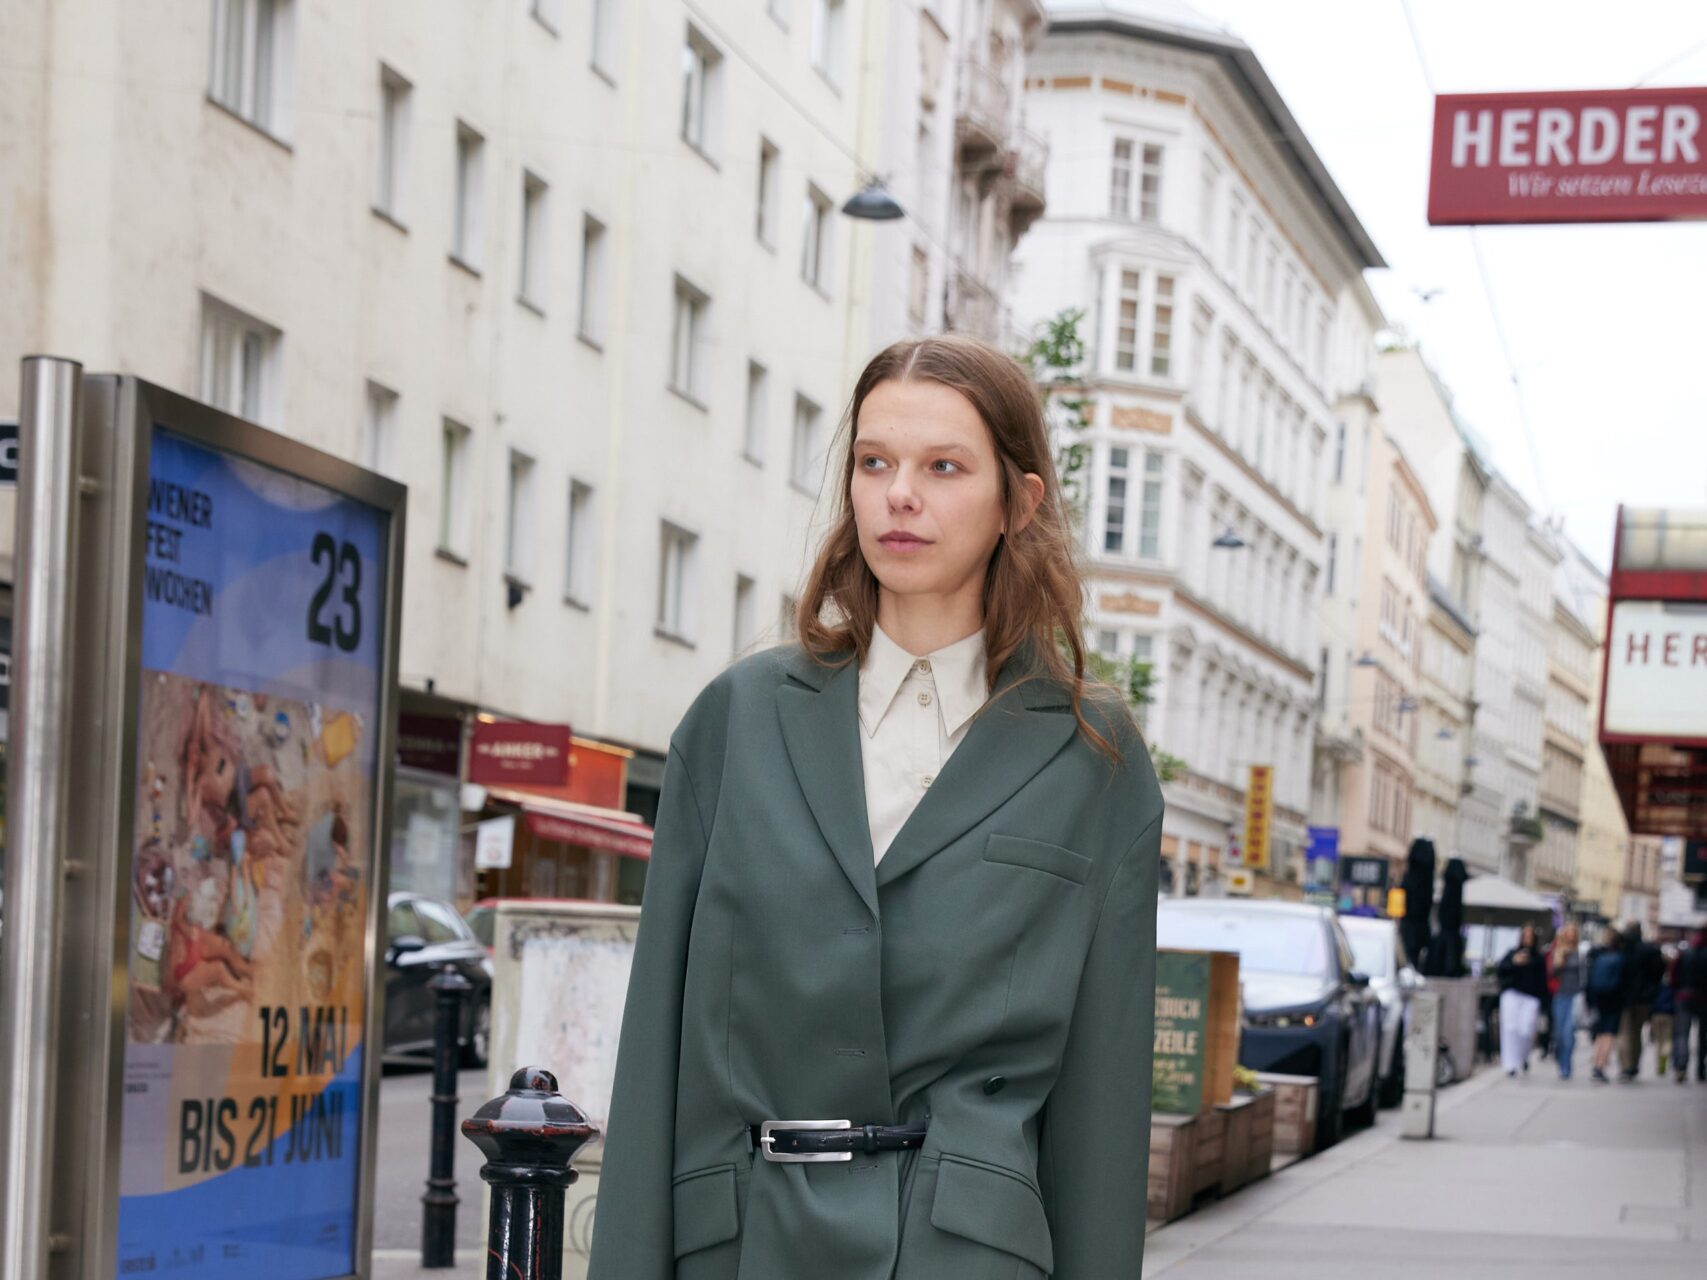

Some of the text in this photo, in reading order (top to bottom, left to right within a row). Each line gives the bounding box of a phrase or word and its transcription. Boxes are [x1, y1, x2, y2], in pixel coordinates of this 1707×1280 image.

[1452, 105, 1700, 168] HERDER
[1508, 172, 1551, 198] Wir
[1555, 174, 1633, 197] setzen
[308, 532, 361, 652] 23
[1626, 633, 1707, 666] HER
[258, 1006, 348, 1078] 12 MAI
[179, 1091, 344, 1174] BIS 21 JUNI
